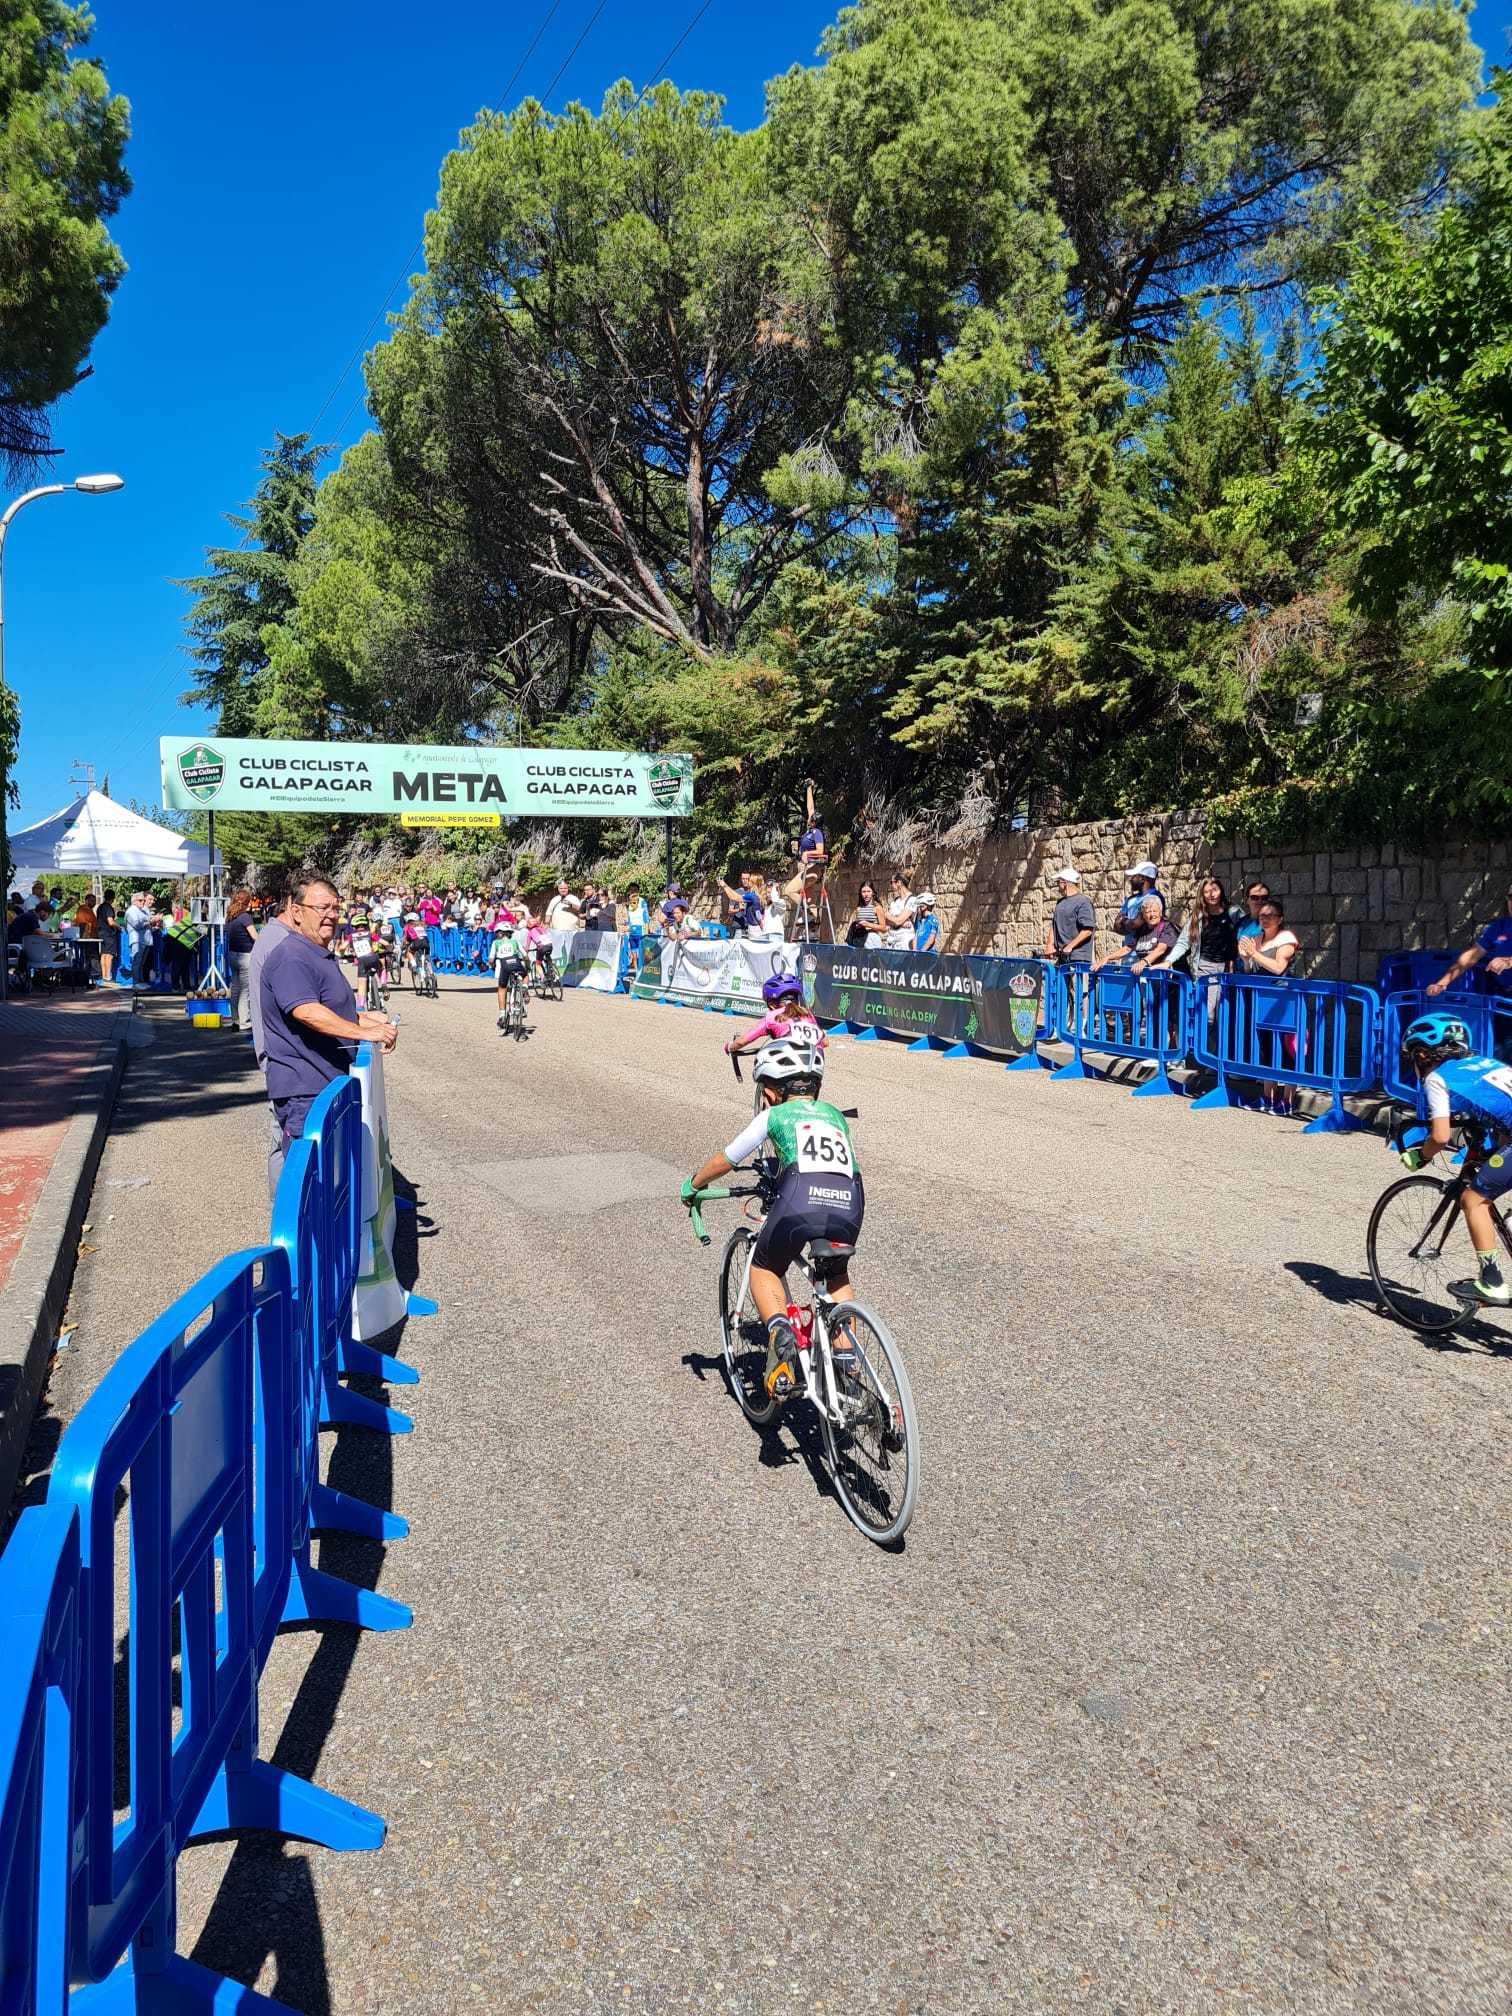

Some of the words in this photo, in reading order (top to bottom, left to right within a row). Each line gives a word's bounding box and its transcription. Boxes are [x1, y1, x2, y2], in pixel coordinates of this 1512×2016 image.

[239, 757, 287, 771] CLUB
[290, 760, 369, 773] CICLISTA
[526, 765, 566, 777] CLUB
[568, 767, 634, 779] CICLISTA
[239, 776, 373, 792] GALAPAGAR
[393, 771, 508, 803] META
[526, 782, 637, 796] GALAPAGAR
[407, 815, 446, 823] MEMORIAL
[832, 964, 858, 980] CLUB
[861, 967, 906, 987] CICLISTA
[910, 972, 983, 998] GALAPAGAR
[865, 1003, 899, 1018] CYCLING
[900, 1009, 939, 1025] ACADEMY
[802, 1135, 849, 1165] 453
[808, 1185, 852, 1201] INGRID
